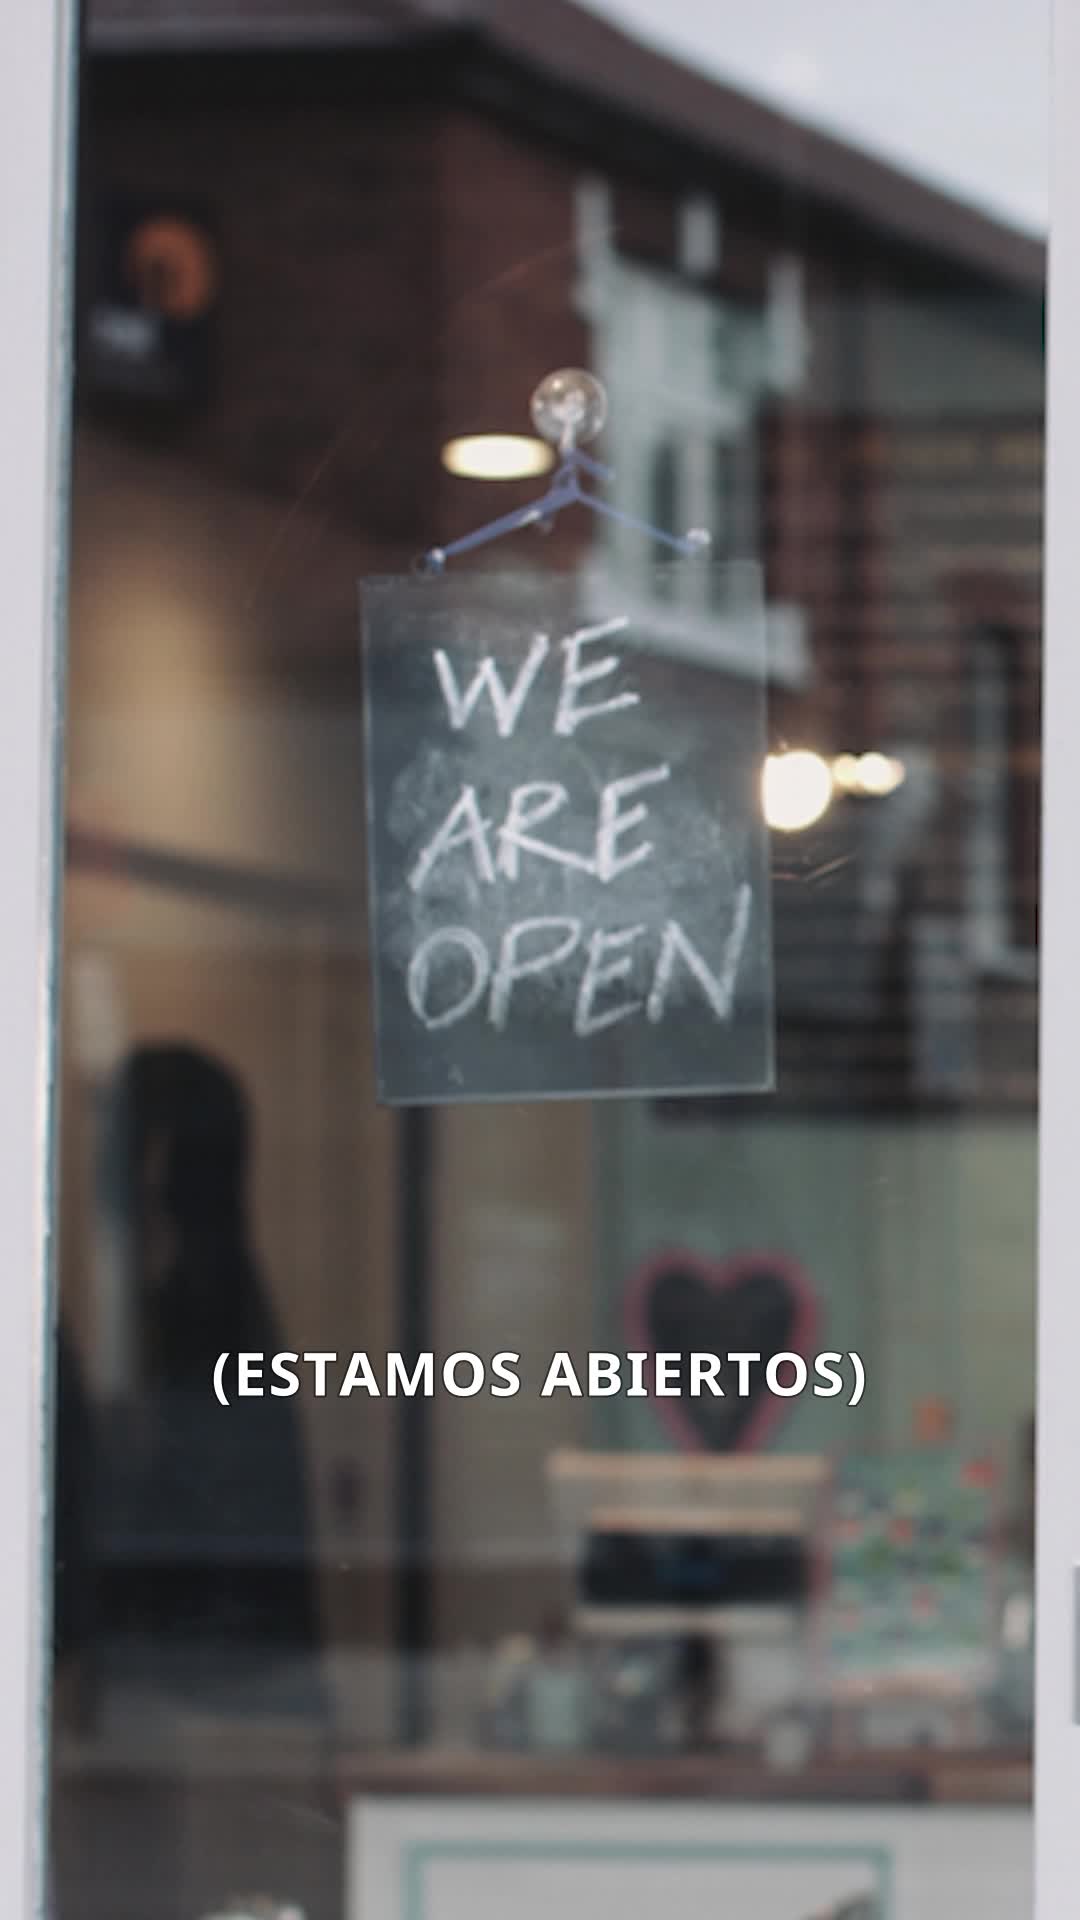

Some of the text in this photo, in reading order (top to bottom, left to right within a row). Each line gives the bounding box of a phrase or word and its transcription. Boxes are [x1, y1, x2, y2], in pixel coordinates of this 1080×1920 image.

[433, 616, 641, 738] WE
[408, 763, 670, 892] ARE
[408, 884, 752, 1038] OPEN
